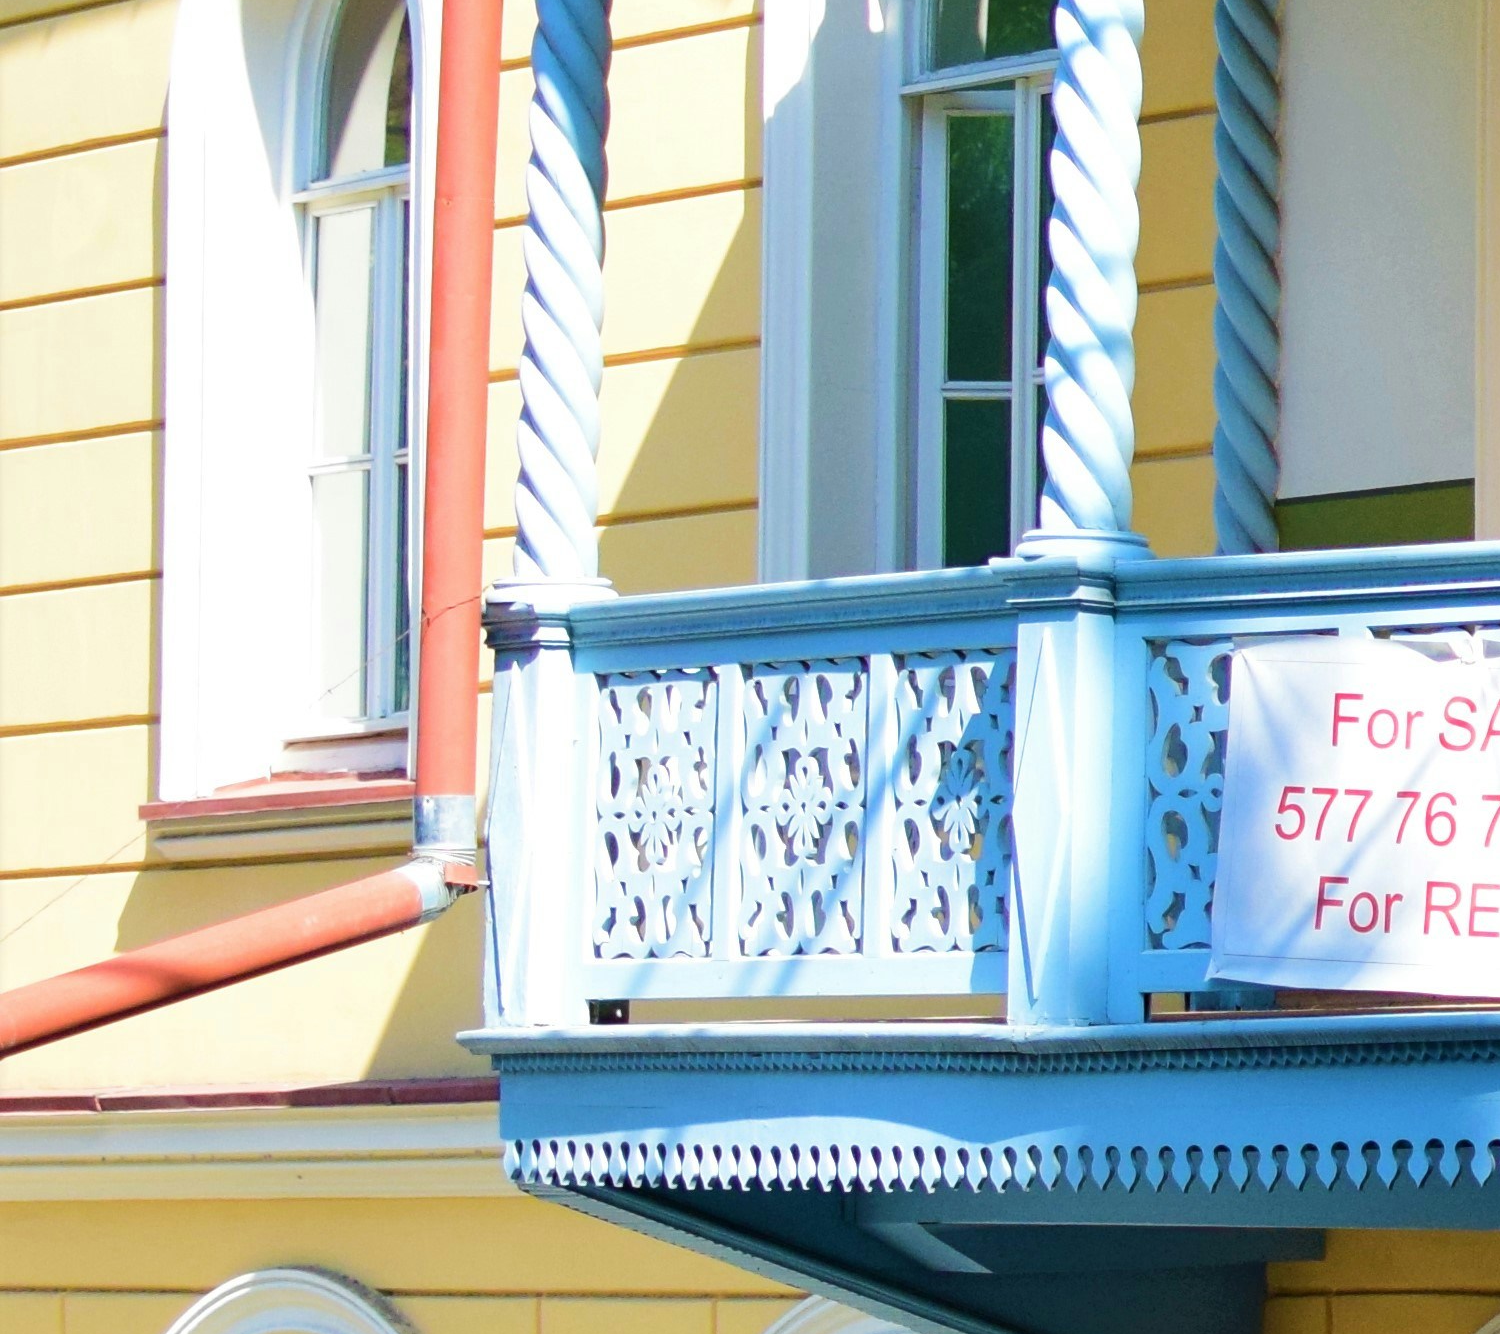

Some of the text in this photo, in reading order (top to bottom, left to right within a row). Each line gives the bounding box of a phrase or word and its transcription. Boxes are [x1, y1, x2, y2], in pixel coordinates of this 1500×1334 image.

[1330, 691, 1425, 750] For
[1273, 784, 1375, 843] 577
[1394, 788, 1458, 848] 76
[1313, 874, 1405, 934] For
